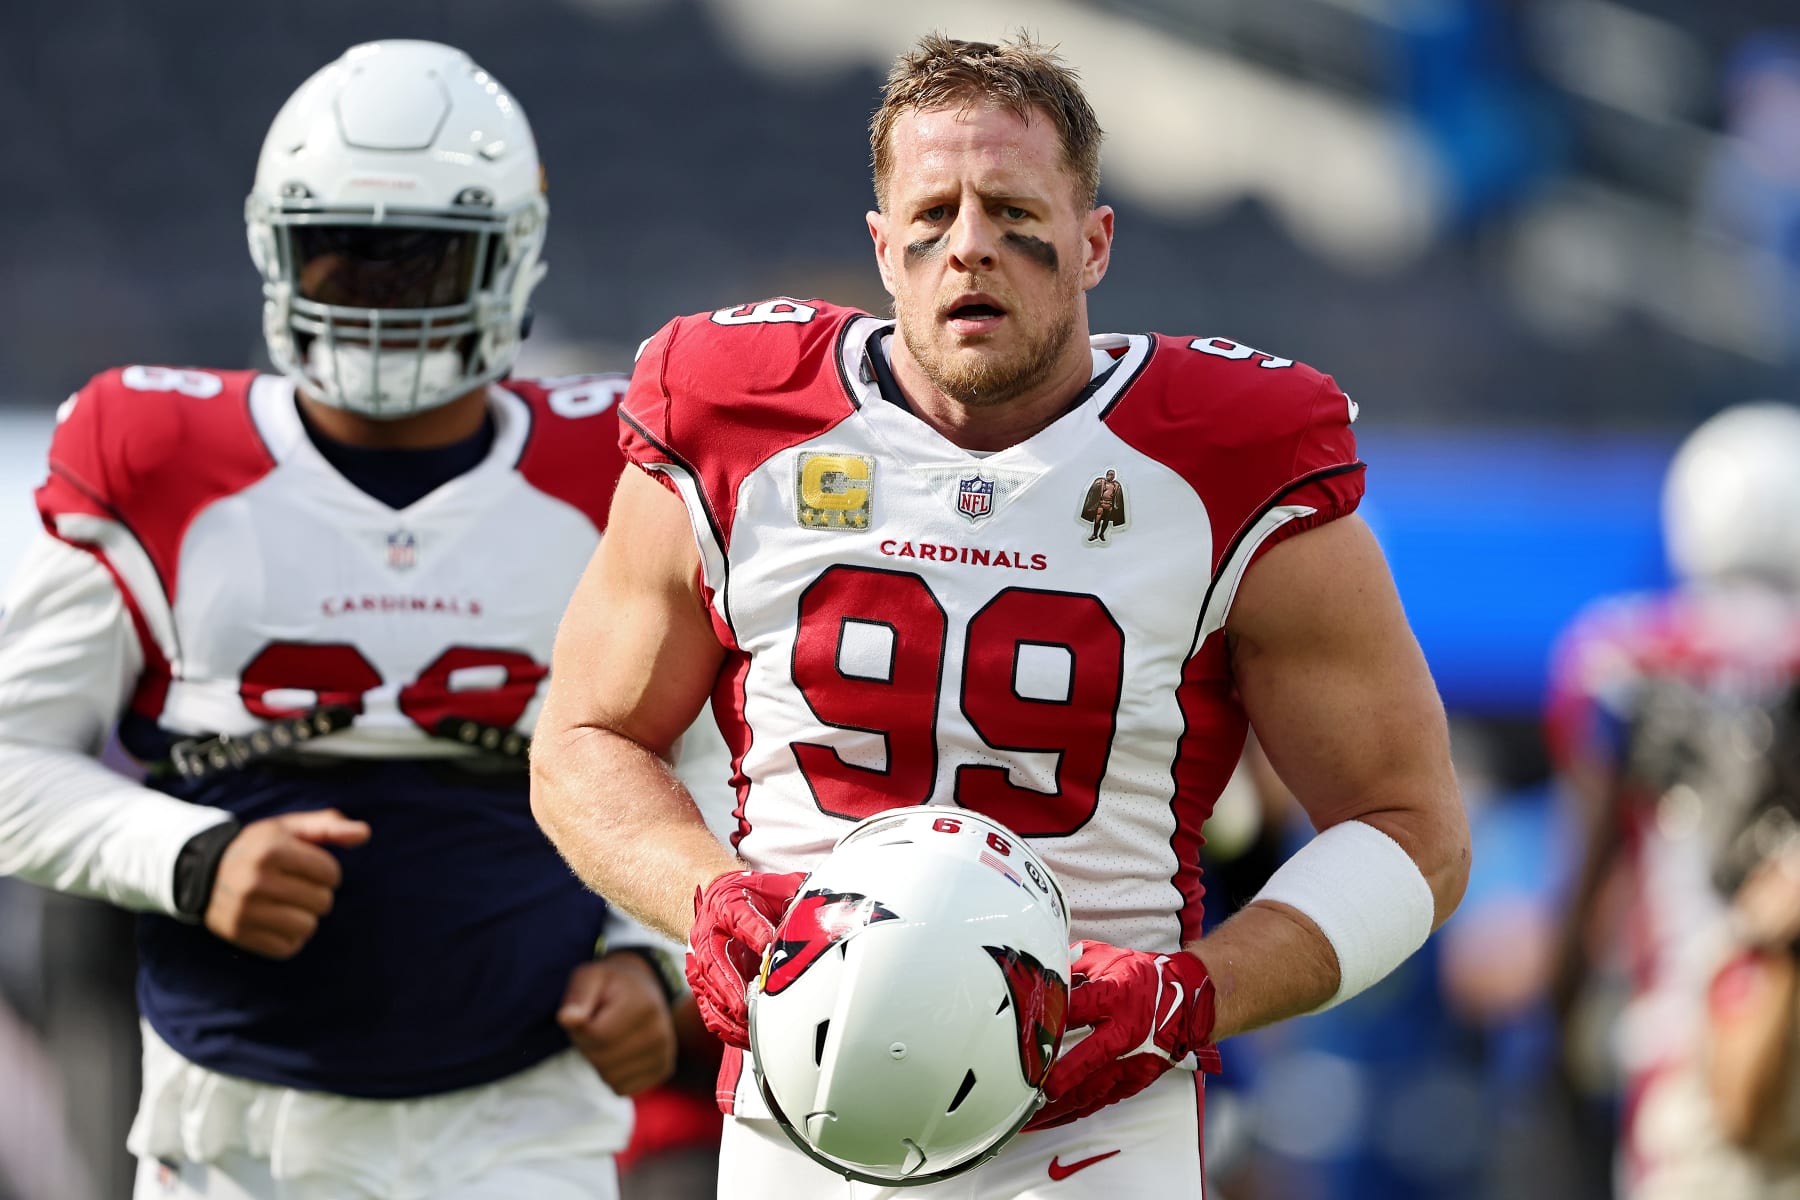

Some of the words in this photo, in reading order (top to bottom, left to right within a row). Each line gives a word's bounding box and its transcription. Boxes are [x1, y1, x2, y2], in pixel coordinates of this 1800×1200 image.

[801, 455, 869, 511] C
[960, 493, 989, 513] NFL
[880, 539, 1048, 571] CARDINALS
[788, 563, 1126, 839] 99
